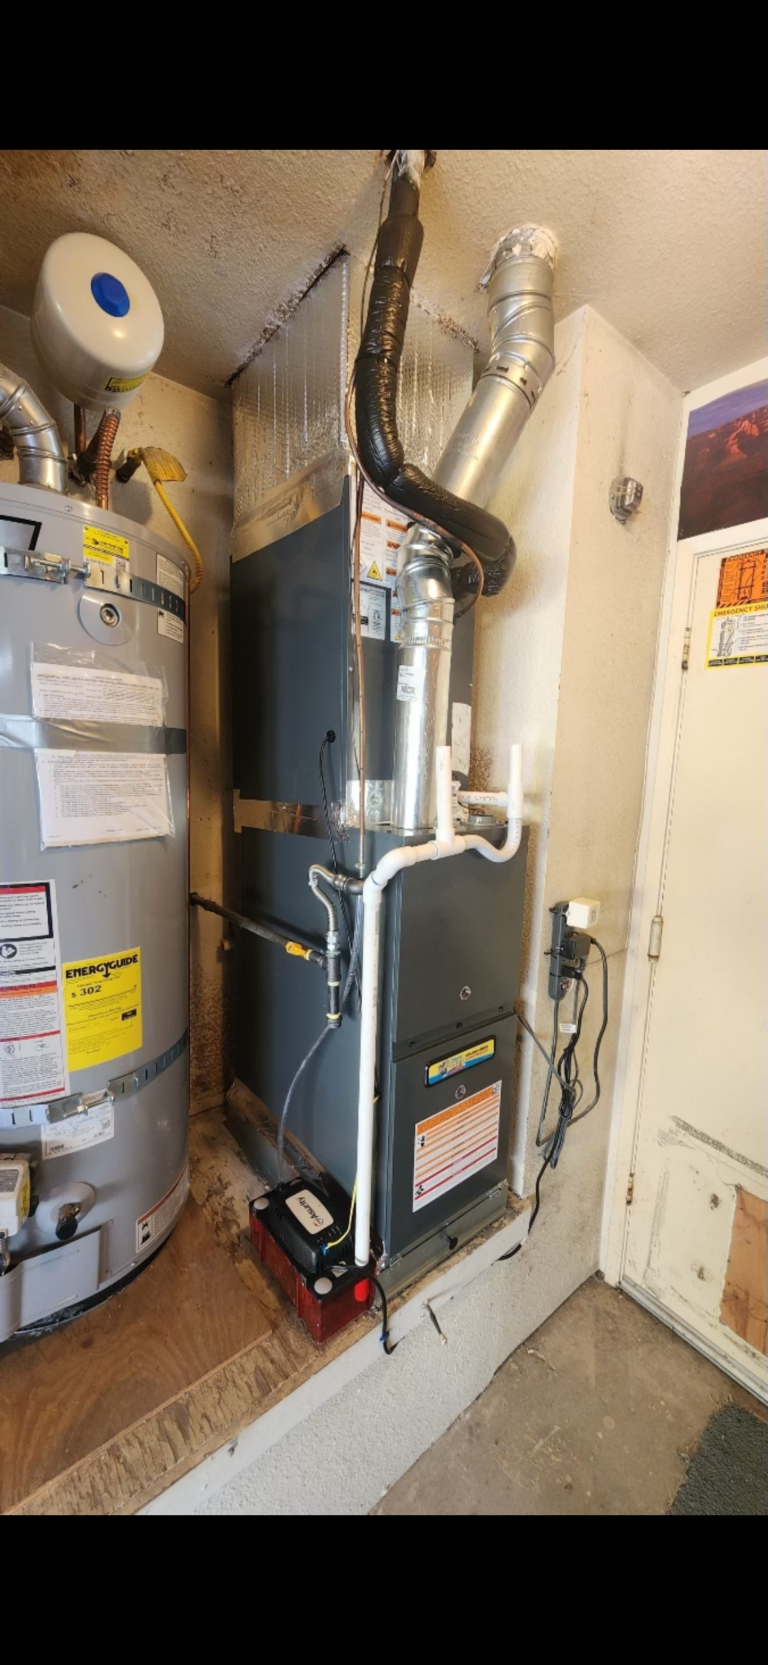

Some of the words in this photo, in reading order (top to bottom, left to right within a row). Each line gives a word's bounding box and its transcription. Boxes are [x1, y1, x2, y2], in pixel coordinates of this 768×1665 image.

[714, 606, 753, 617] EMERGENCY
[66, 954, 138, 978] ENERGYGUIDE
[80, 985, 101, 996] 302
[297, 1197, 318, 1218] Asurity
